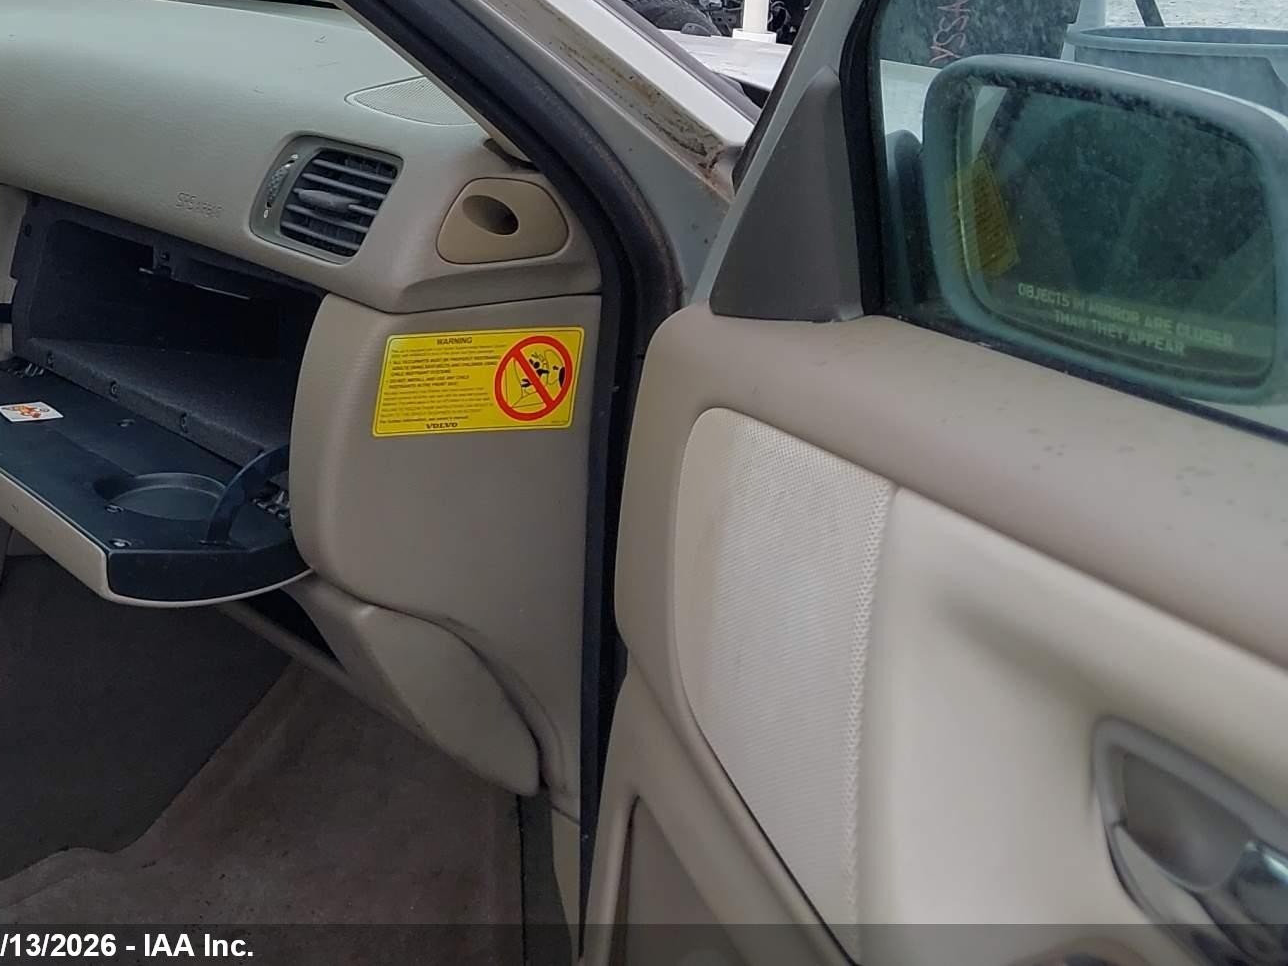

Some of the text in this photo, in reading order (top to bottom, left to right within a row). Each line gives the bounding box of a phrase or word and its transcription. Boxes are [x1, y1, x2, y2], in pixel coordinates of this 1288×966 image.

[1018, 283, 1234, 349] OBJECTS IN MIRROR ARE CLOSER
[436, 336, 473, 346] WARNING
[1055, 310, 1186, 356] THAN THEY APPEAR
[425, 422, 458, 430] VOLVO
